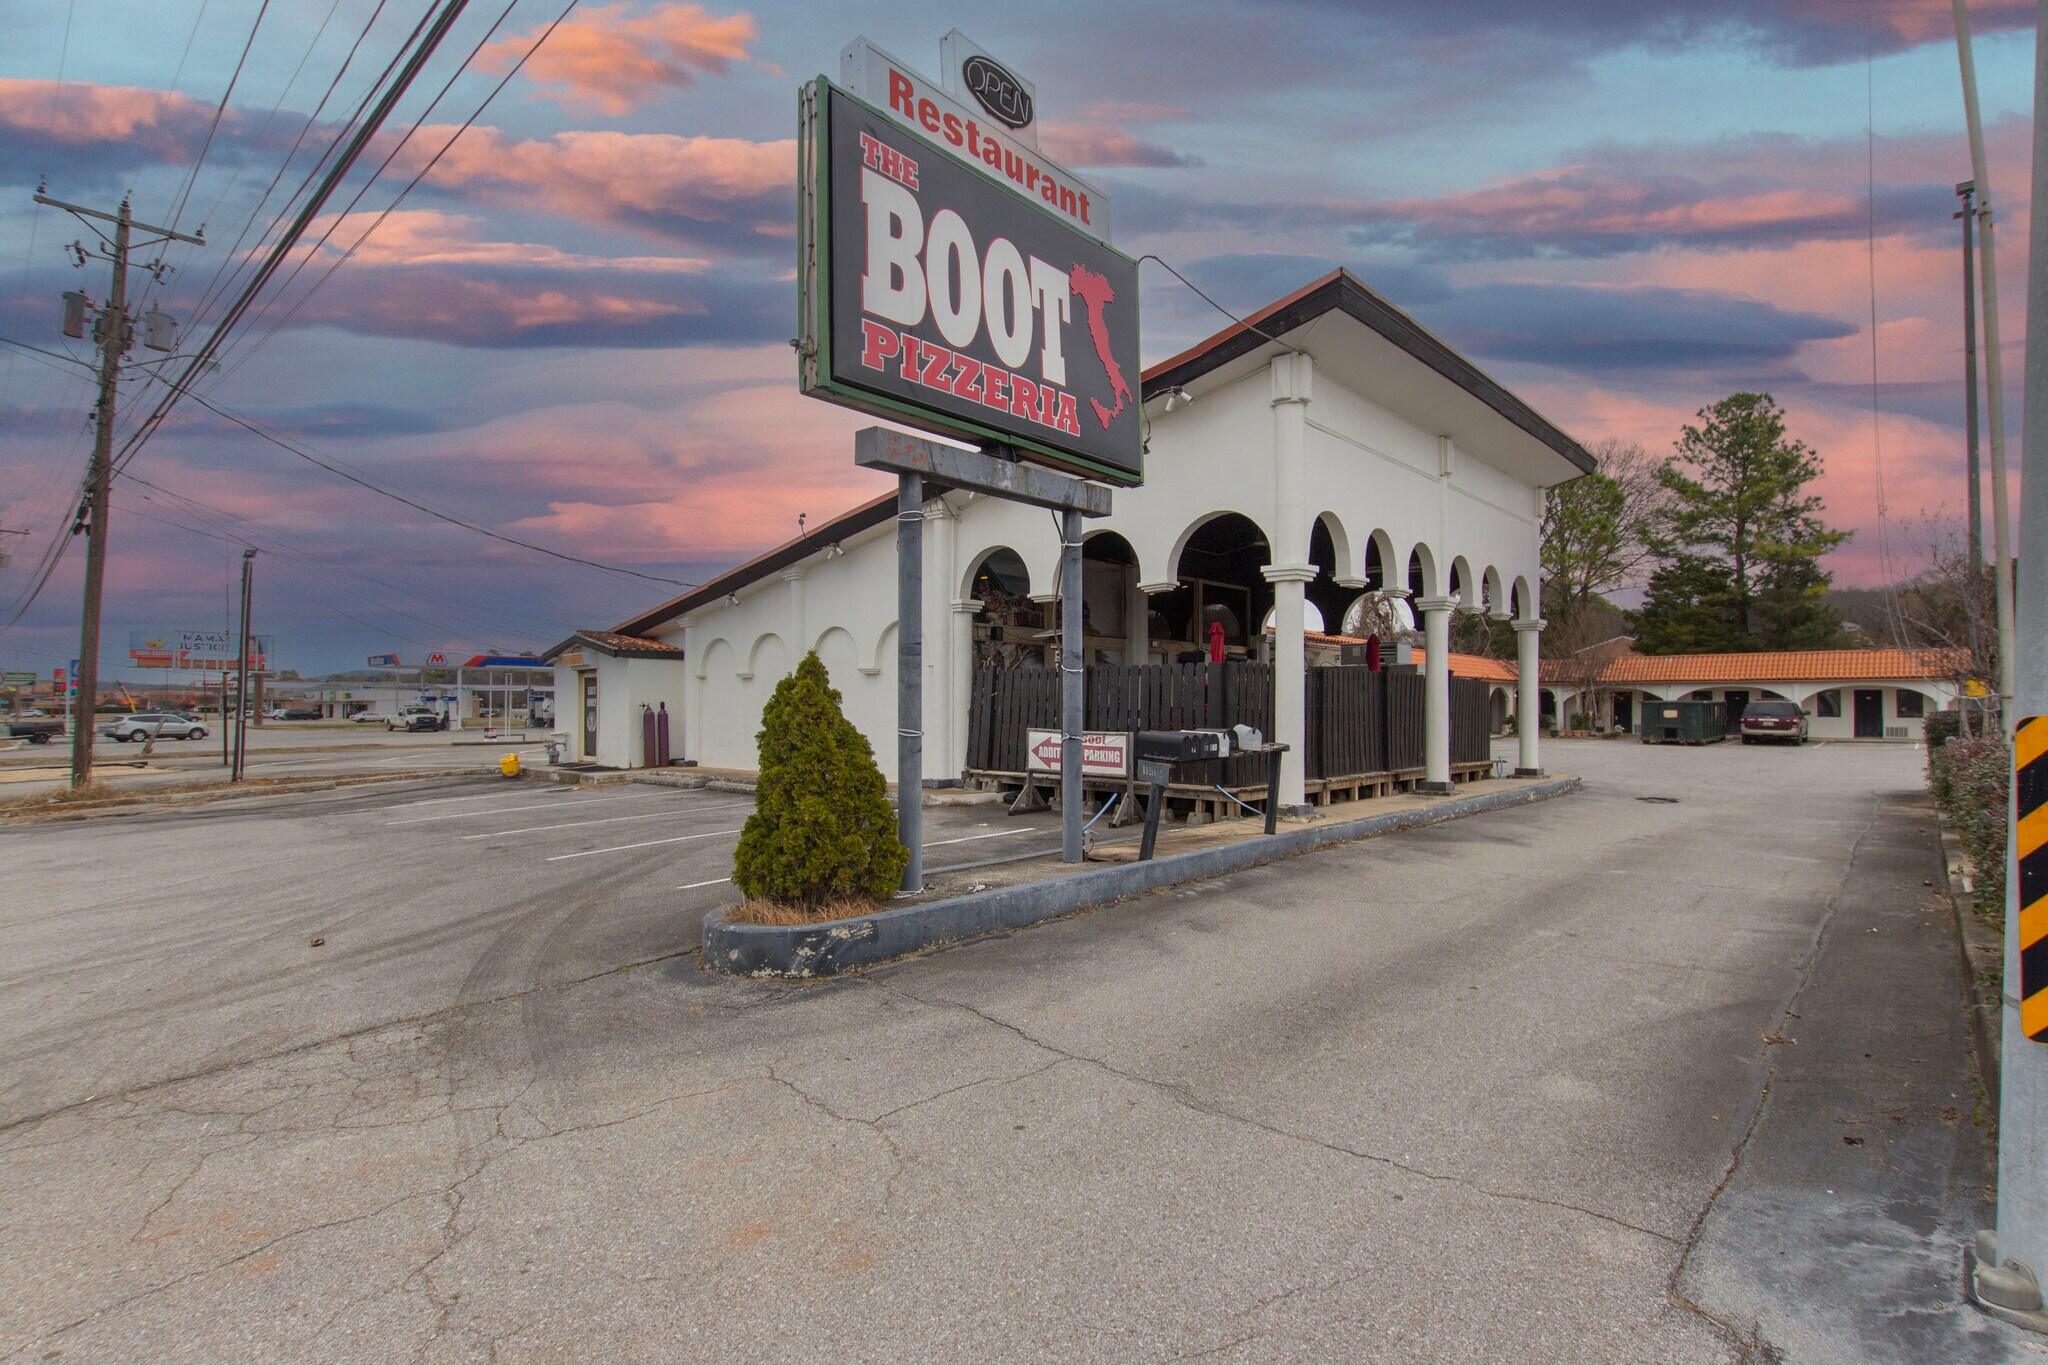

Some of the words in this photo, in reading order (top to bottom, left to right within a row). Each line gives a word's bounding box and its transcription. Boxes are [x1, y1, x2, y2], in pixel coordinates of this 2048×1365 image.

[967, 61, 1030, 122] OPEN
[859, 131, 920, 192] THE
[889, 67, 1091, 226] Restaurant
[861, 166, 1072, 387] BOOT
[861, 318, 1082, 437] PIZZERIA
[1038, 746, 1061, 759] ADDIT
[1084, 749, 1120, 763] PARKING
